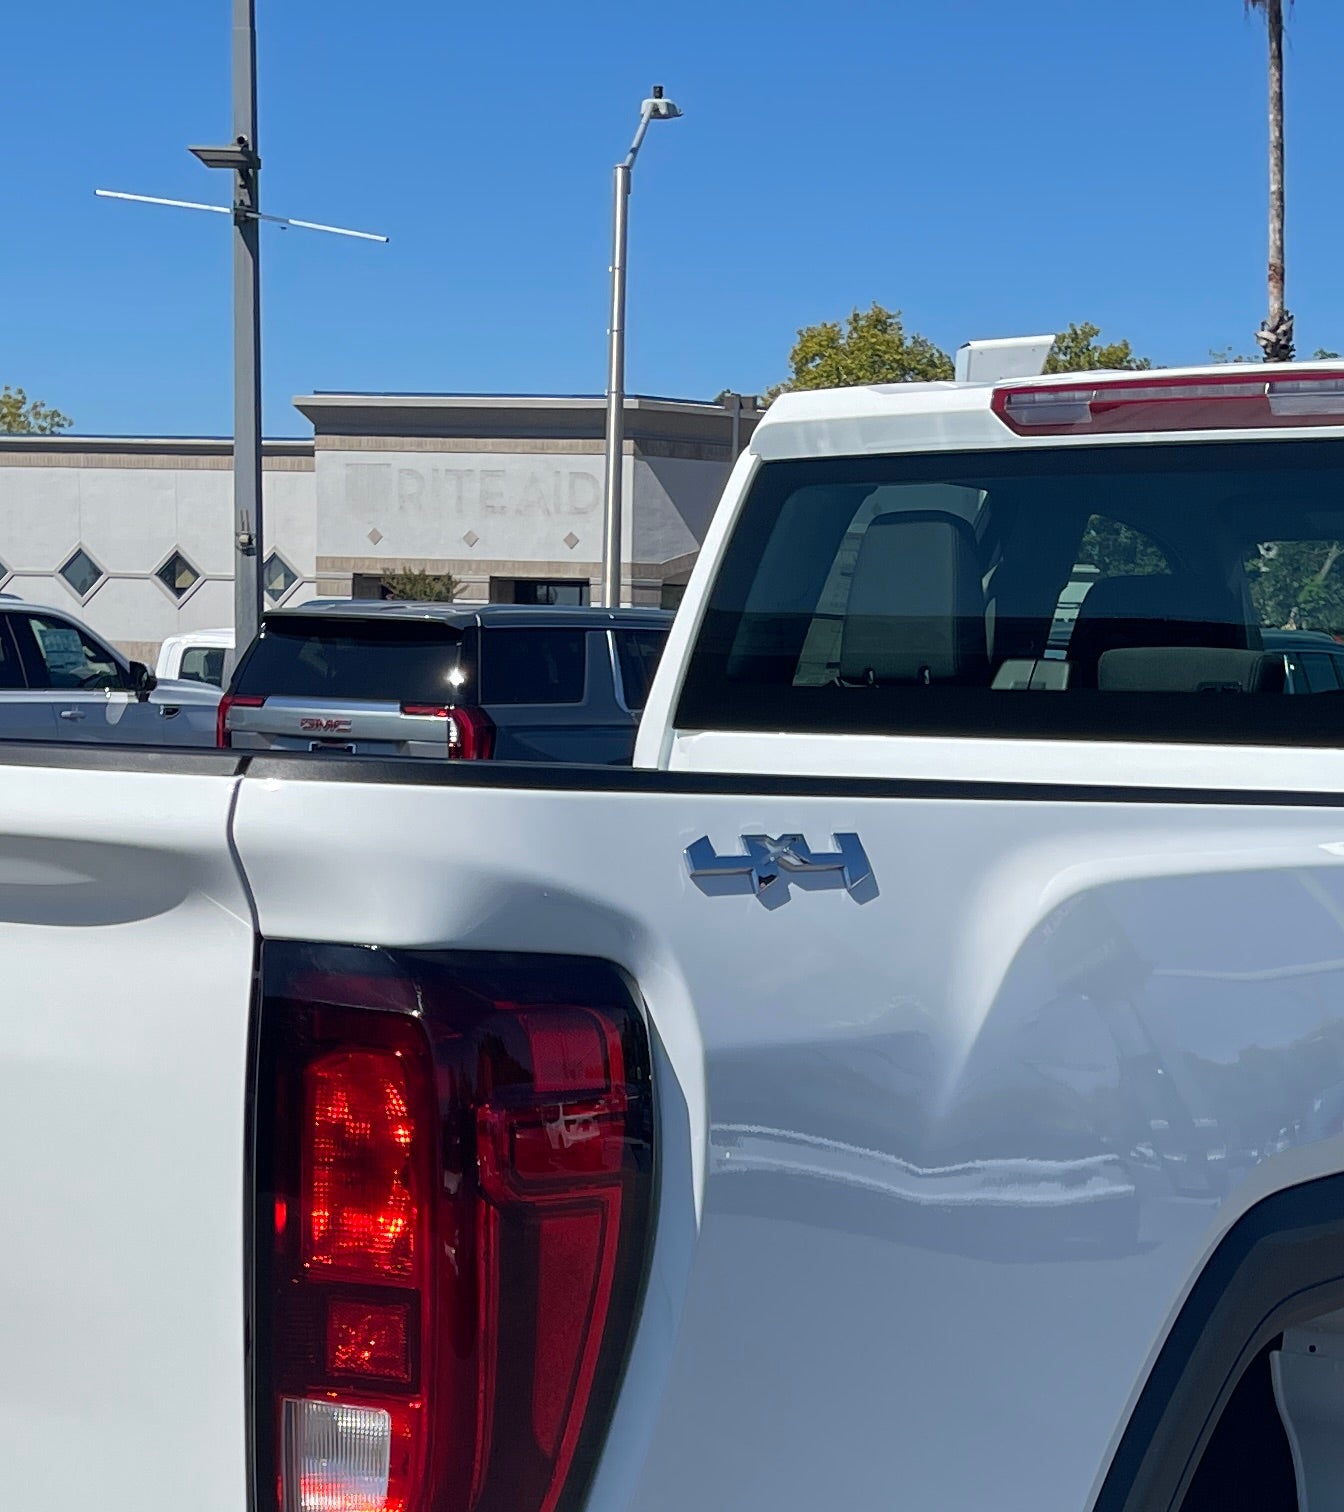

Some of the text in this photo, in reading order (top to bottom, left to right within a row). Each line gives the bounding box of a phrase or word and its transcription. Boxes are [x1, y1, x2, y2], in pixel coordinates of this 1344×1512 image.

[397, 468, 602, 516] RITE AID
[299, 717, 353, 734] GMC
